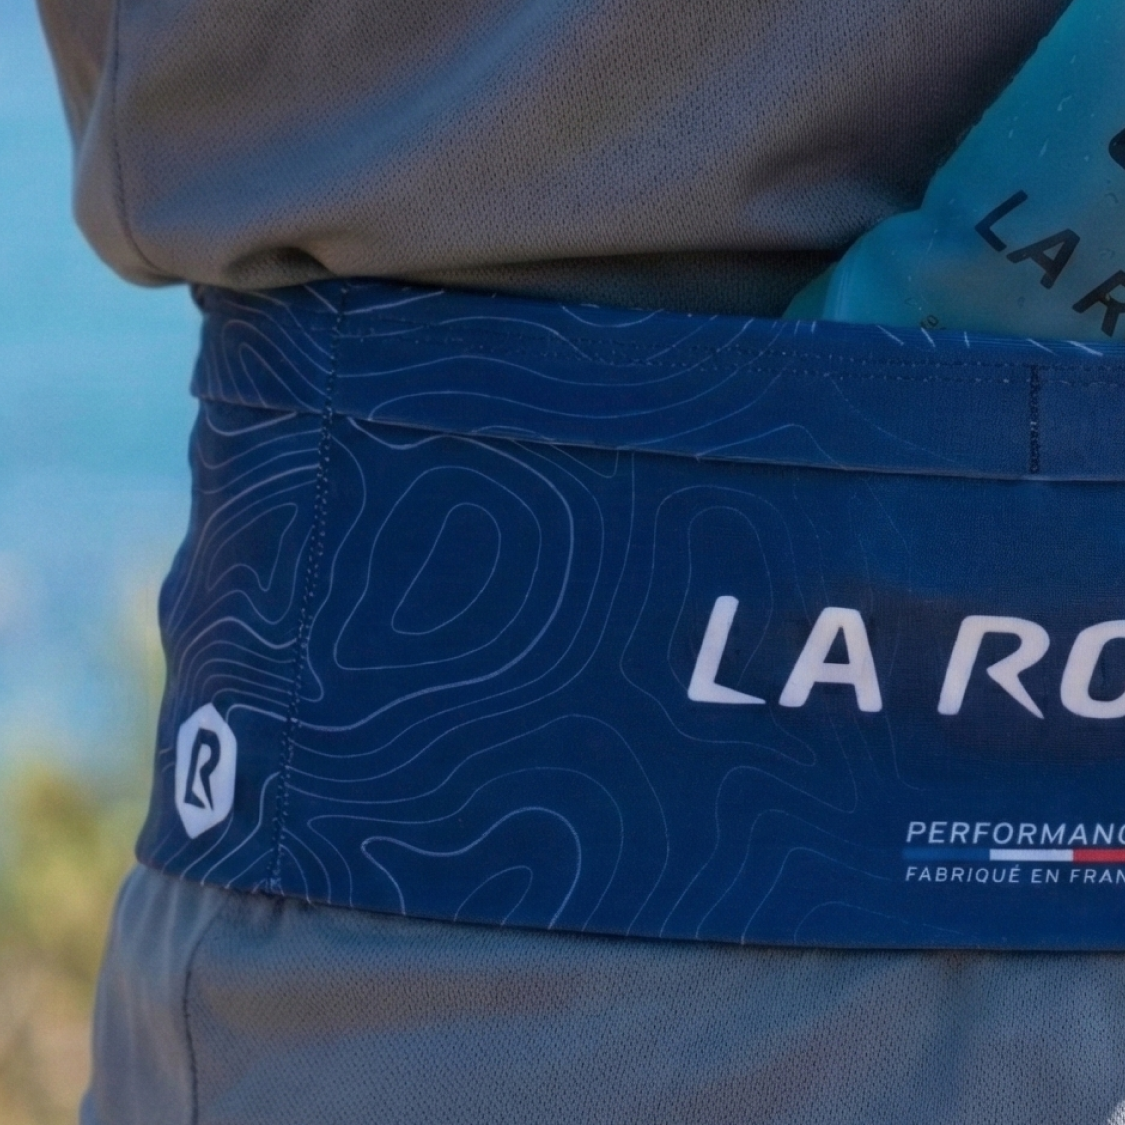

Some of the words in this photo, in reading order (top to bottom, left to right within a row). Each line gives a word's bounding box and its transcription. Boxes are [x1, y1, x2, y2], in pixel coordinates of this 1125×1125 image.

[975, 189, 1081, 290] LA
[689, 595, 882, 712] LA
[905, 864, 1021, 884] FABRIQUÉ
[1030, 868, 1060, 884] EN
